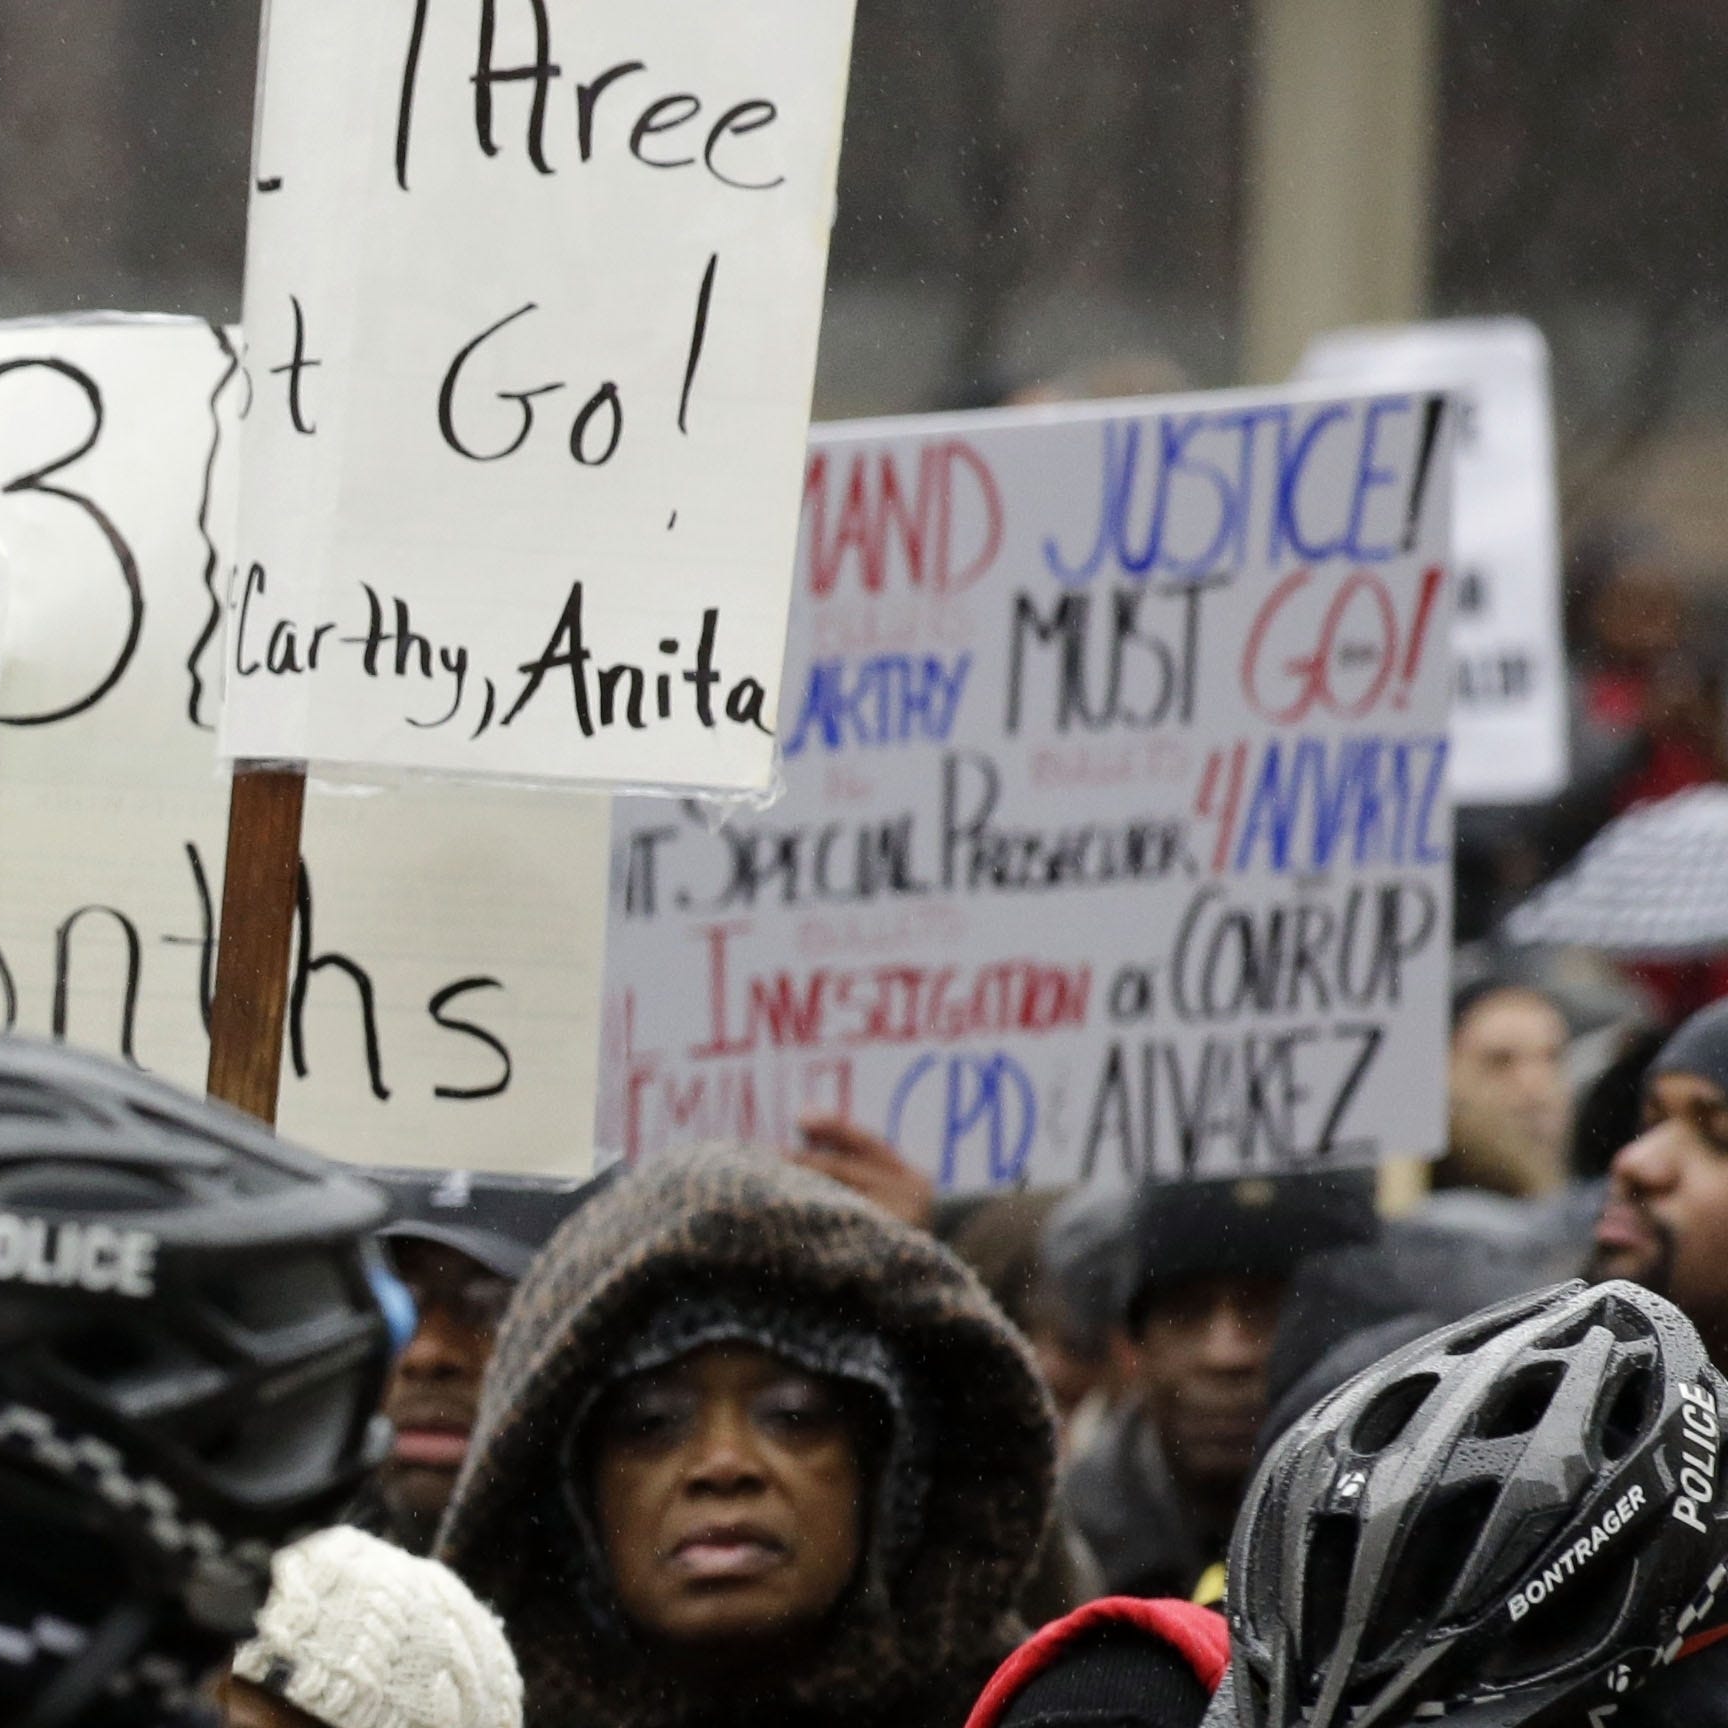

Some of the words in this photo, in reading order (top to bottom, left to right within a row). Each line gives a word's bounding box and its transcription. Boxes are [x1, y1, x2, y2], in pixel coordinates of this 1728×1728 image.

[1043, 390, 1448, 586] JUSTICE!
[499, 579, 776, 738] Anita
[1004, 573, 1231, 738] MUST
[1239, 562, 1448, 726] GO!
[1672, 1382, 1719, 1535] POLICE
[1505, 1483, 1648, 1623] BONTRAGER
